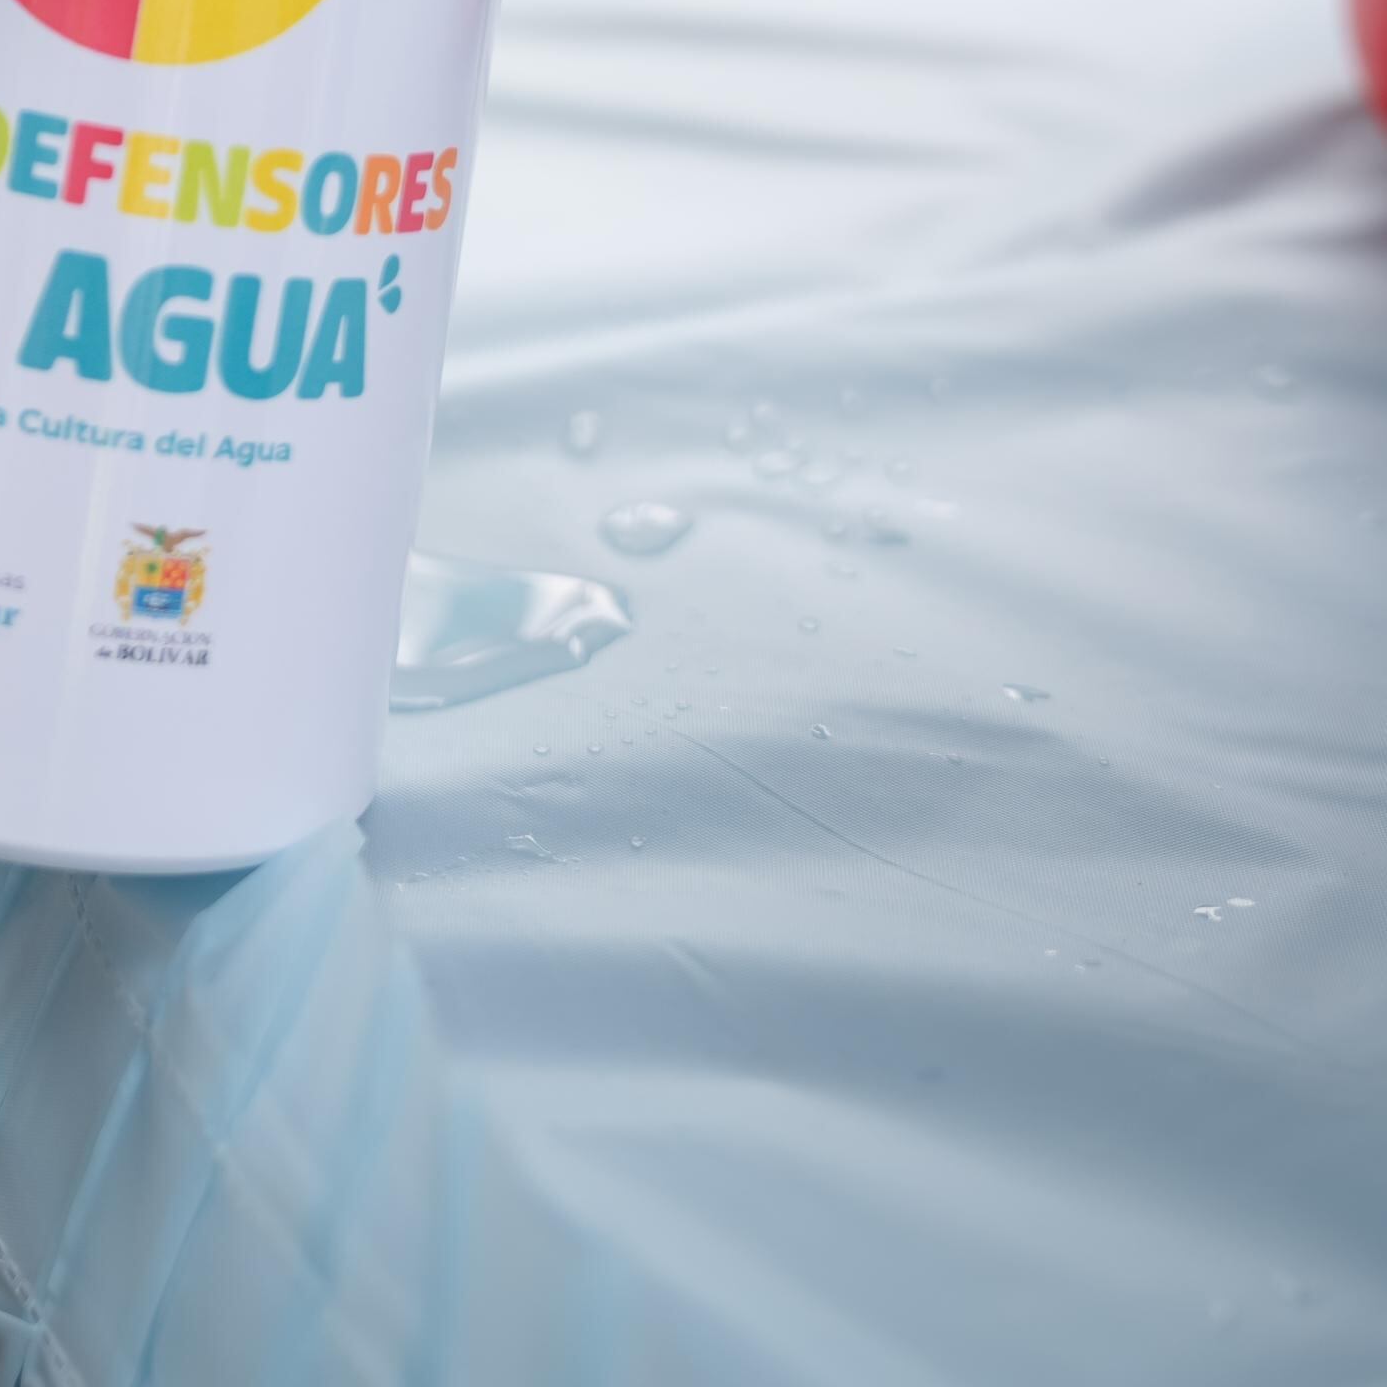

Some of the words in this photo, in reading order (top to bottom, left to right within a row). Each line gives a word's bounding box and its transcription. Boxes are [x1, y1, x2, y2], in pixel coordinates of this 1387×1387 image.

[16, 248, 368, 401] AGUA
[18, 408, 146, 452] Cultura
[155, 430, 206, 458] del
[215, 434, 293, 468] Agua
